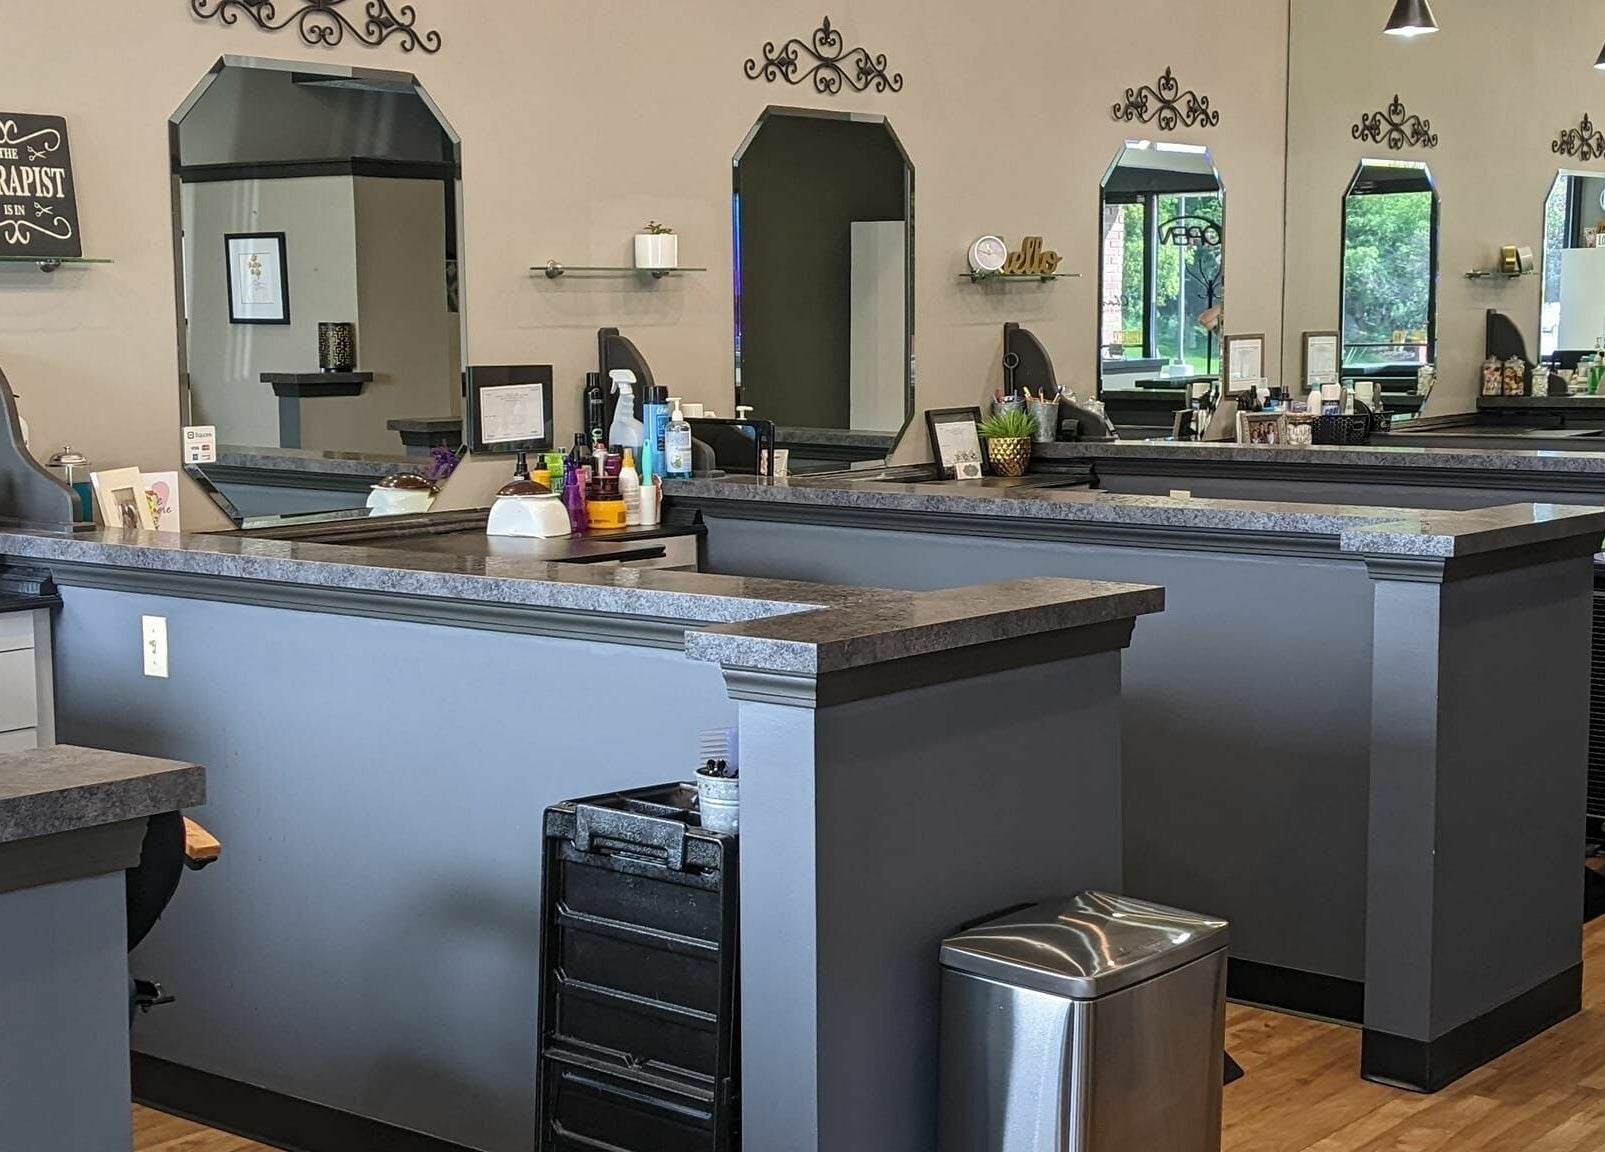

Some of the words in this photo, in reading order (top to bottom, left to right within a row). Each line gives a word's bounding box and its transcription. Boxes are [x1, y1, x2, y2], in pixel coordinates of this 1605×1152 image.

[3, 204, 13, 215] IS
[14, 204, 26, 216] IN
[1000, 236, 1062, 274] ello
